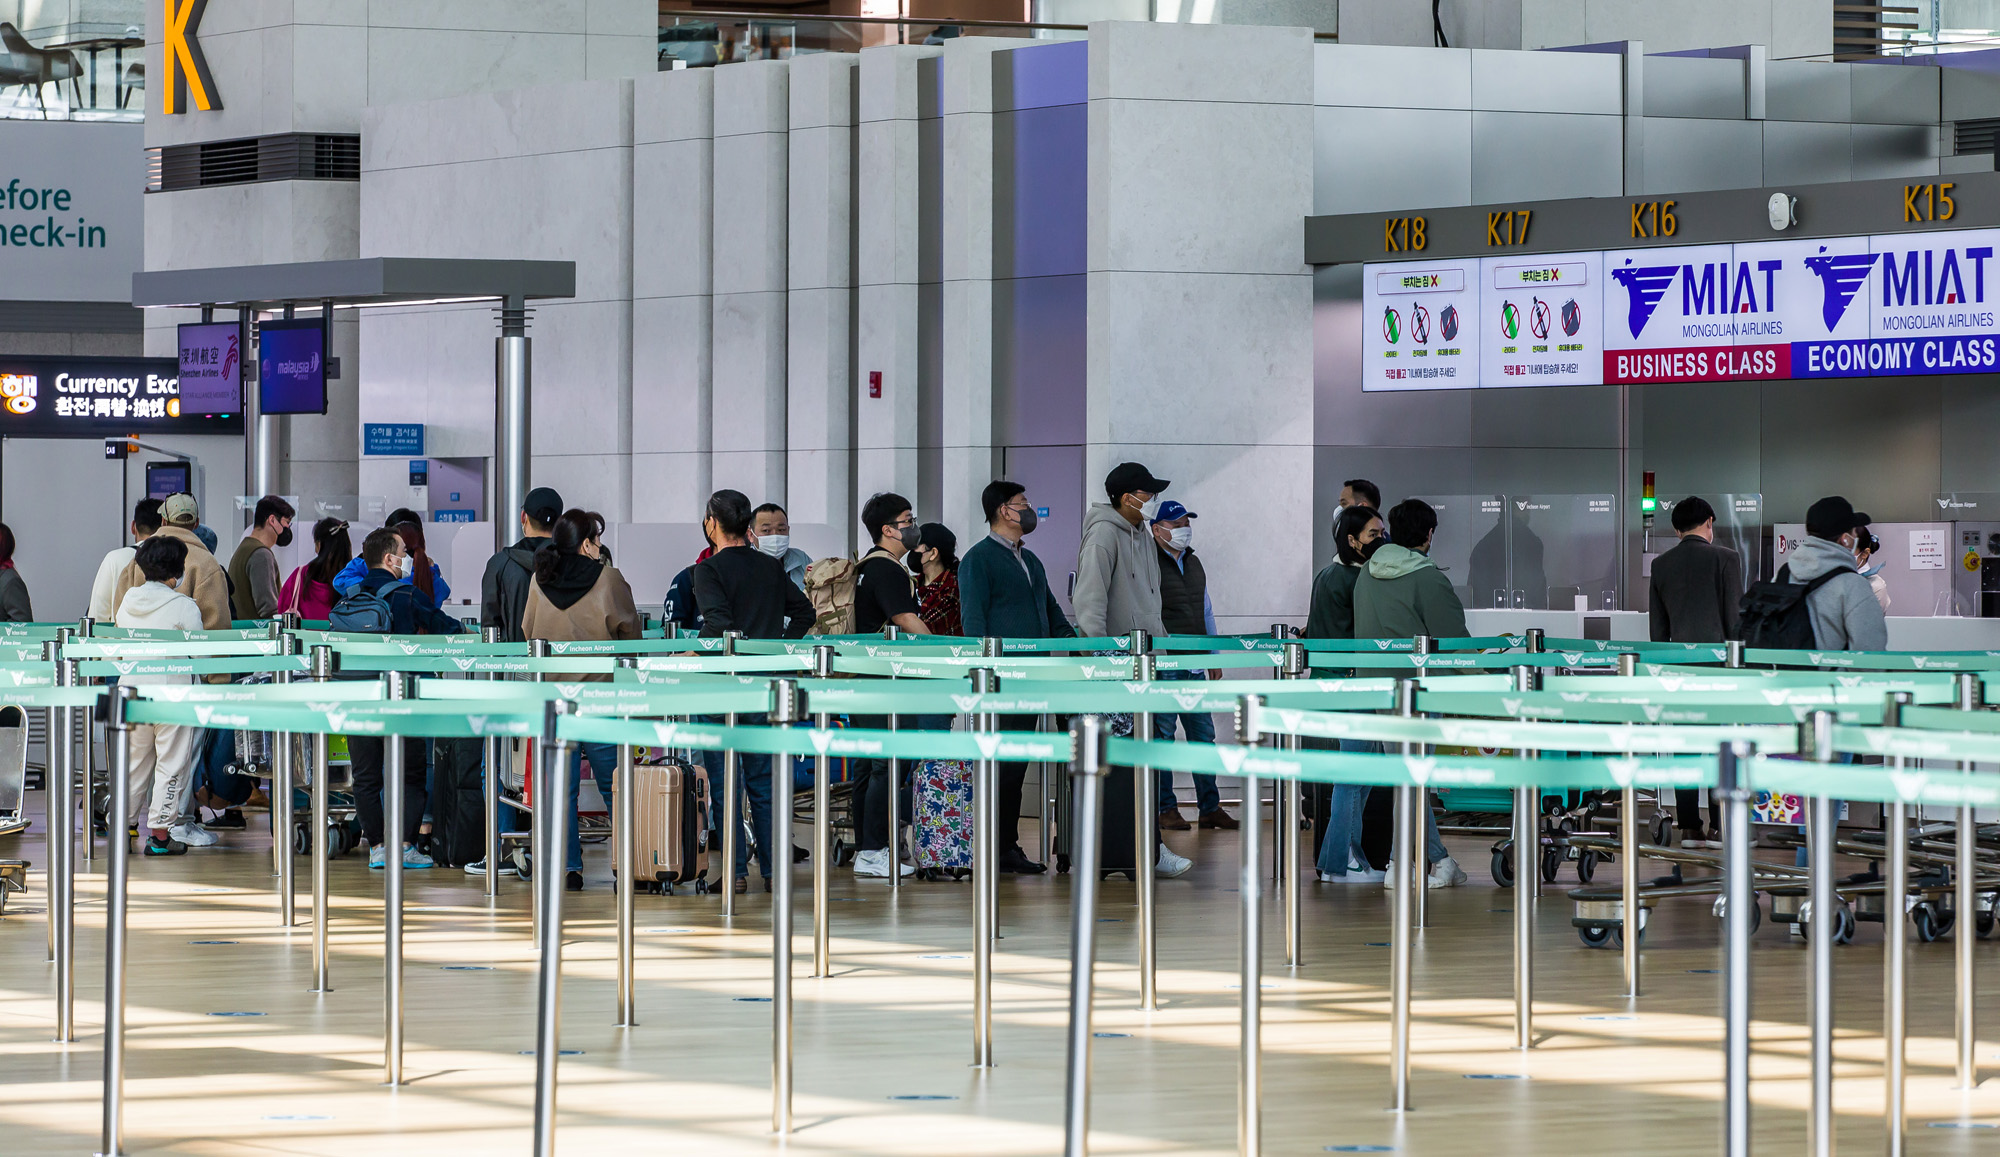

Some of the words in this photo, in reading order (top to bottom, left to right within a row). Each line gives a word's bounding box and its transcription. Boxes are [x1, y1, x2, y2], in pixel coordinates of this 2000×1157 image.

[164, 0, 210, 114] K
[1905, 184, 1953, 221] K15
[1632, 201, 1674, 237] K16
[1386, 218, 1424, 250] K18
[1488, 211, 1529, 245] K17
[1404, 276, 1421, 288] 부치는
[1422, 275, 1429, 288] 짐
[1523, 270, 1541, 282] 부치는
[1542, 269, 1549, 281] 짐
[1882, 246, 1993, 307] MIAT
[1682, 260, 1783, 316] MIAT
[1682, 323, 1739, 338] MONGOLIAN
[1741, 321, 1783, 336] AIRLINES
[1882, 315, 1945, 331] MONGOLIAN
[1947, 312, 1994, 329] AIRLINES
[181, 346, 219, 365] 深圳航空
[1808, 342, 1916, 372] ECONOMY
[1923, 338, 1996, 369] CLASS
[180, 369, 201, 378] Shenzhen
[202, 368, 219, 377] Airlines
[278, 360, 309, 378] malaysia
[1504, 365, 1514, 376] 직접
[1527, 365, 1543, 376] 기내에
[1544, 364, 1559, 375] 탑승해
[1560, 363, 1579, 374] 주세요!
[1618, 352, 1709, 379] BUSINESS
[1715, 350, 1777, 376] CLASS
[1386, 369, 1396, 380] 직접
[1407, 368, 1422, 379] 기내에
[1423, 367, 1438, 379] 탑승해
[1439, 367, 1457, 378] 주세요!
[55, 373, 139, 398] Currency
[119, 647, 143, 655] Incheon
[144, 647, 167, 656] Airport
[444, 647, 465, 656] Airport
[594, 644, 615, 653] Airport
[1017, 643, 1037, 651] Airport
[136, 665, 165, 673] Incheon
[167, 664, 193, 674] Airport
[475, 662, 502, 670] Incheon
[504, 662, 529, 671] Airport
[650, 662, 676, 670] Incheon
[678, 662, 702, 671] Airport
[1156, 660, 1178, 669] Airport
[1429, 658, 1452, 666] Incheon
[1454, 658, 1476, 667] Airport
[165, 774, 179, 800] YOUR
